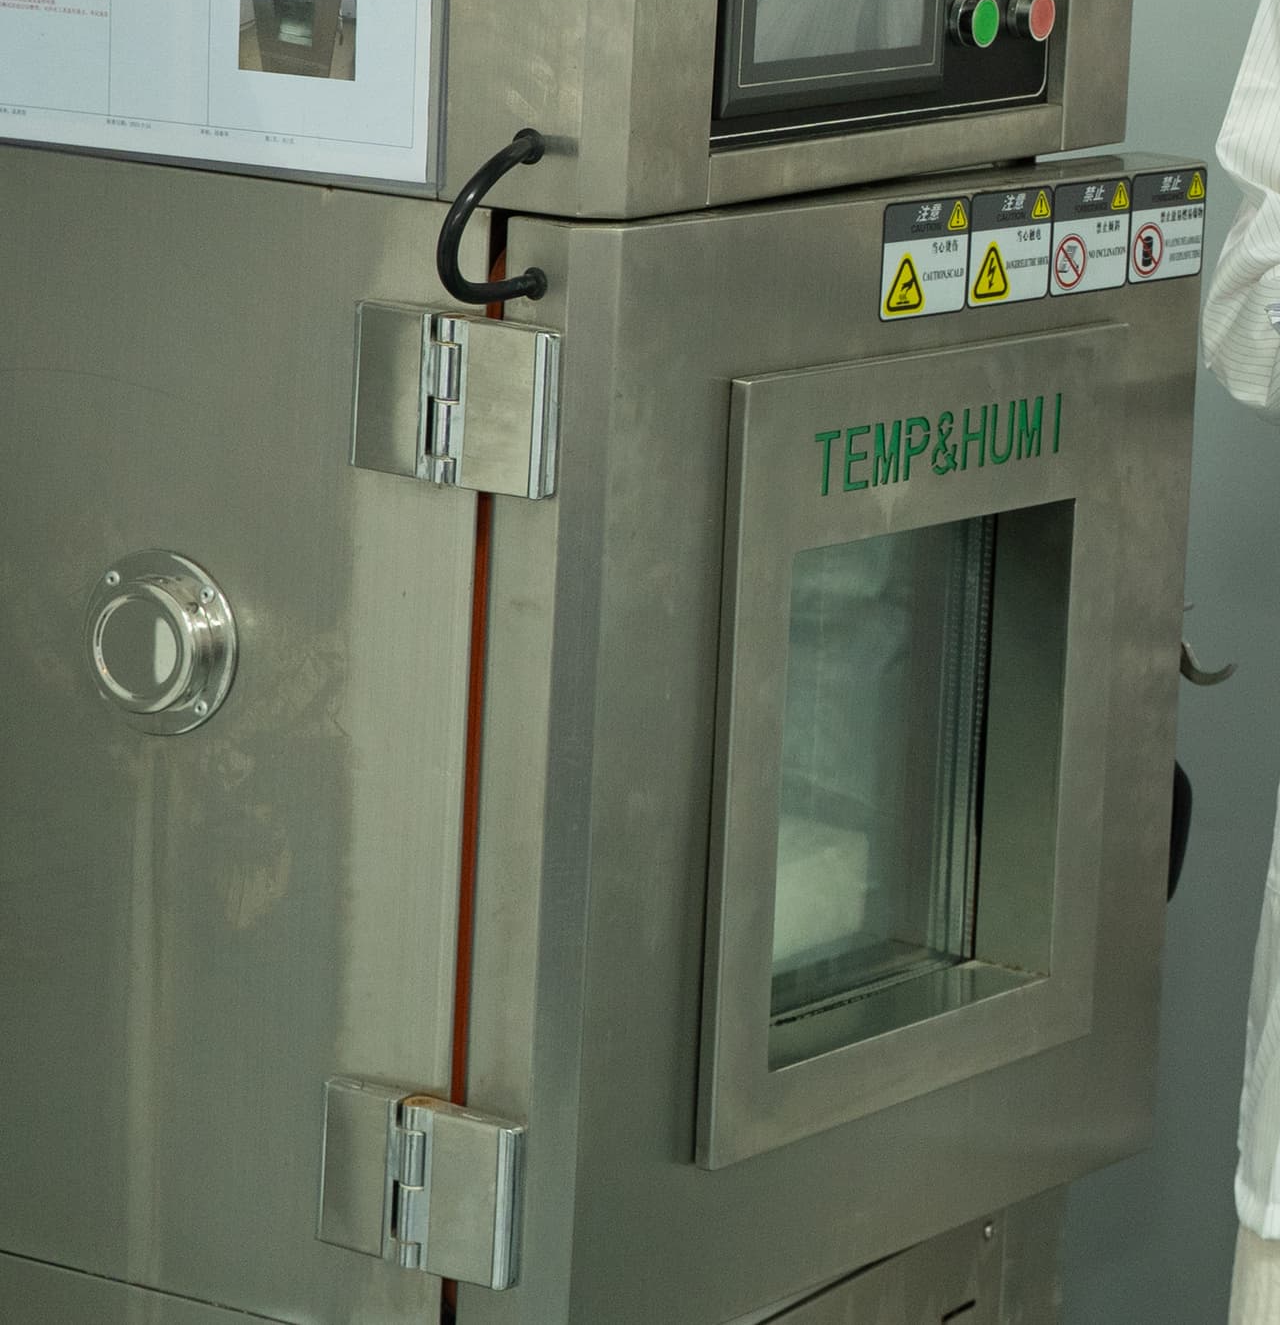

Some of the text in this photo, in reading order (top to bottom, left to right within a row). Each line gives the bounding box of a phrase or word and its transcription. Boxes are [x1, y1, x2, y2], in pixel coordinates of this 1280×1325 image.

[1082, 184, 1106, 203] 禁止
[1159, 175, 1182, 193] 禁止
[1000, 192, 1027, 212] 注意
[915, 202, 943, 223] 注意
[814, 392, 1063, 497] TEMP&HUMI
